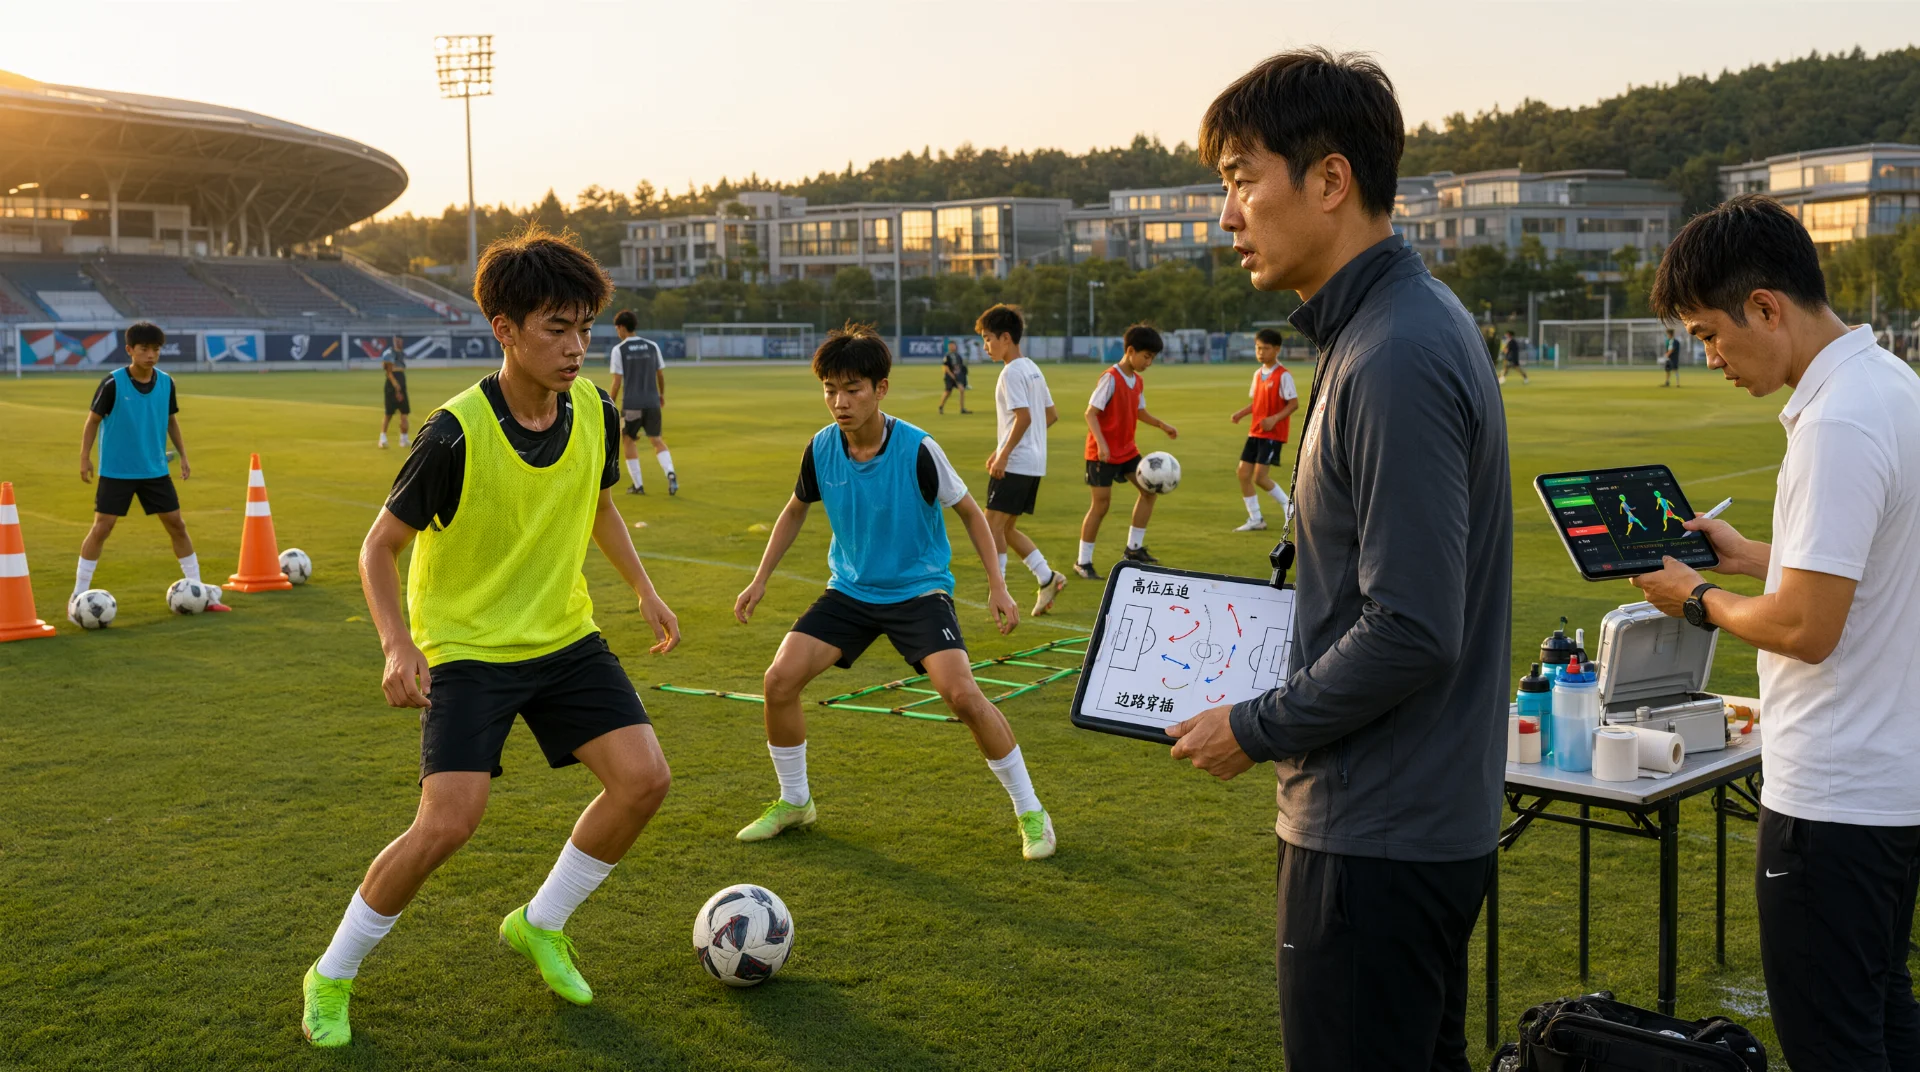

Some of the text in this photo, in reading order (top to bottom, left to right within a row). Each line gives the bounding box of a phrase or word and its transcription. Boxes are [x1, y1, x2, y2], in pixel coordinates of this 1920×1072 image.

[1132, 577, 1190, 600] 高位压迫
[1115, 691, 1174, 713] 边路穿插
